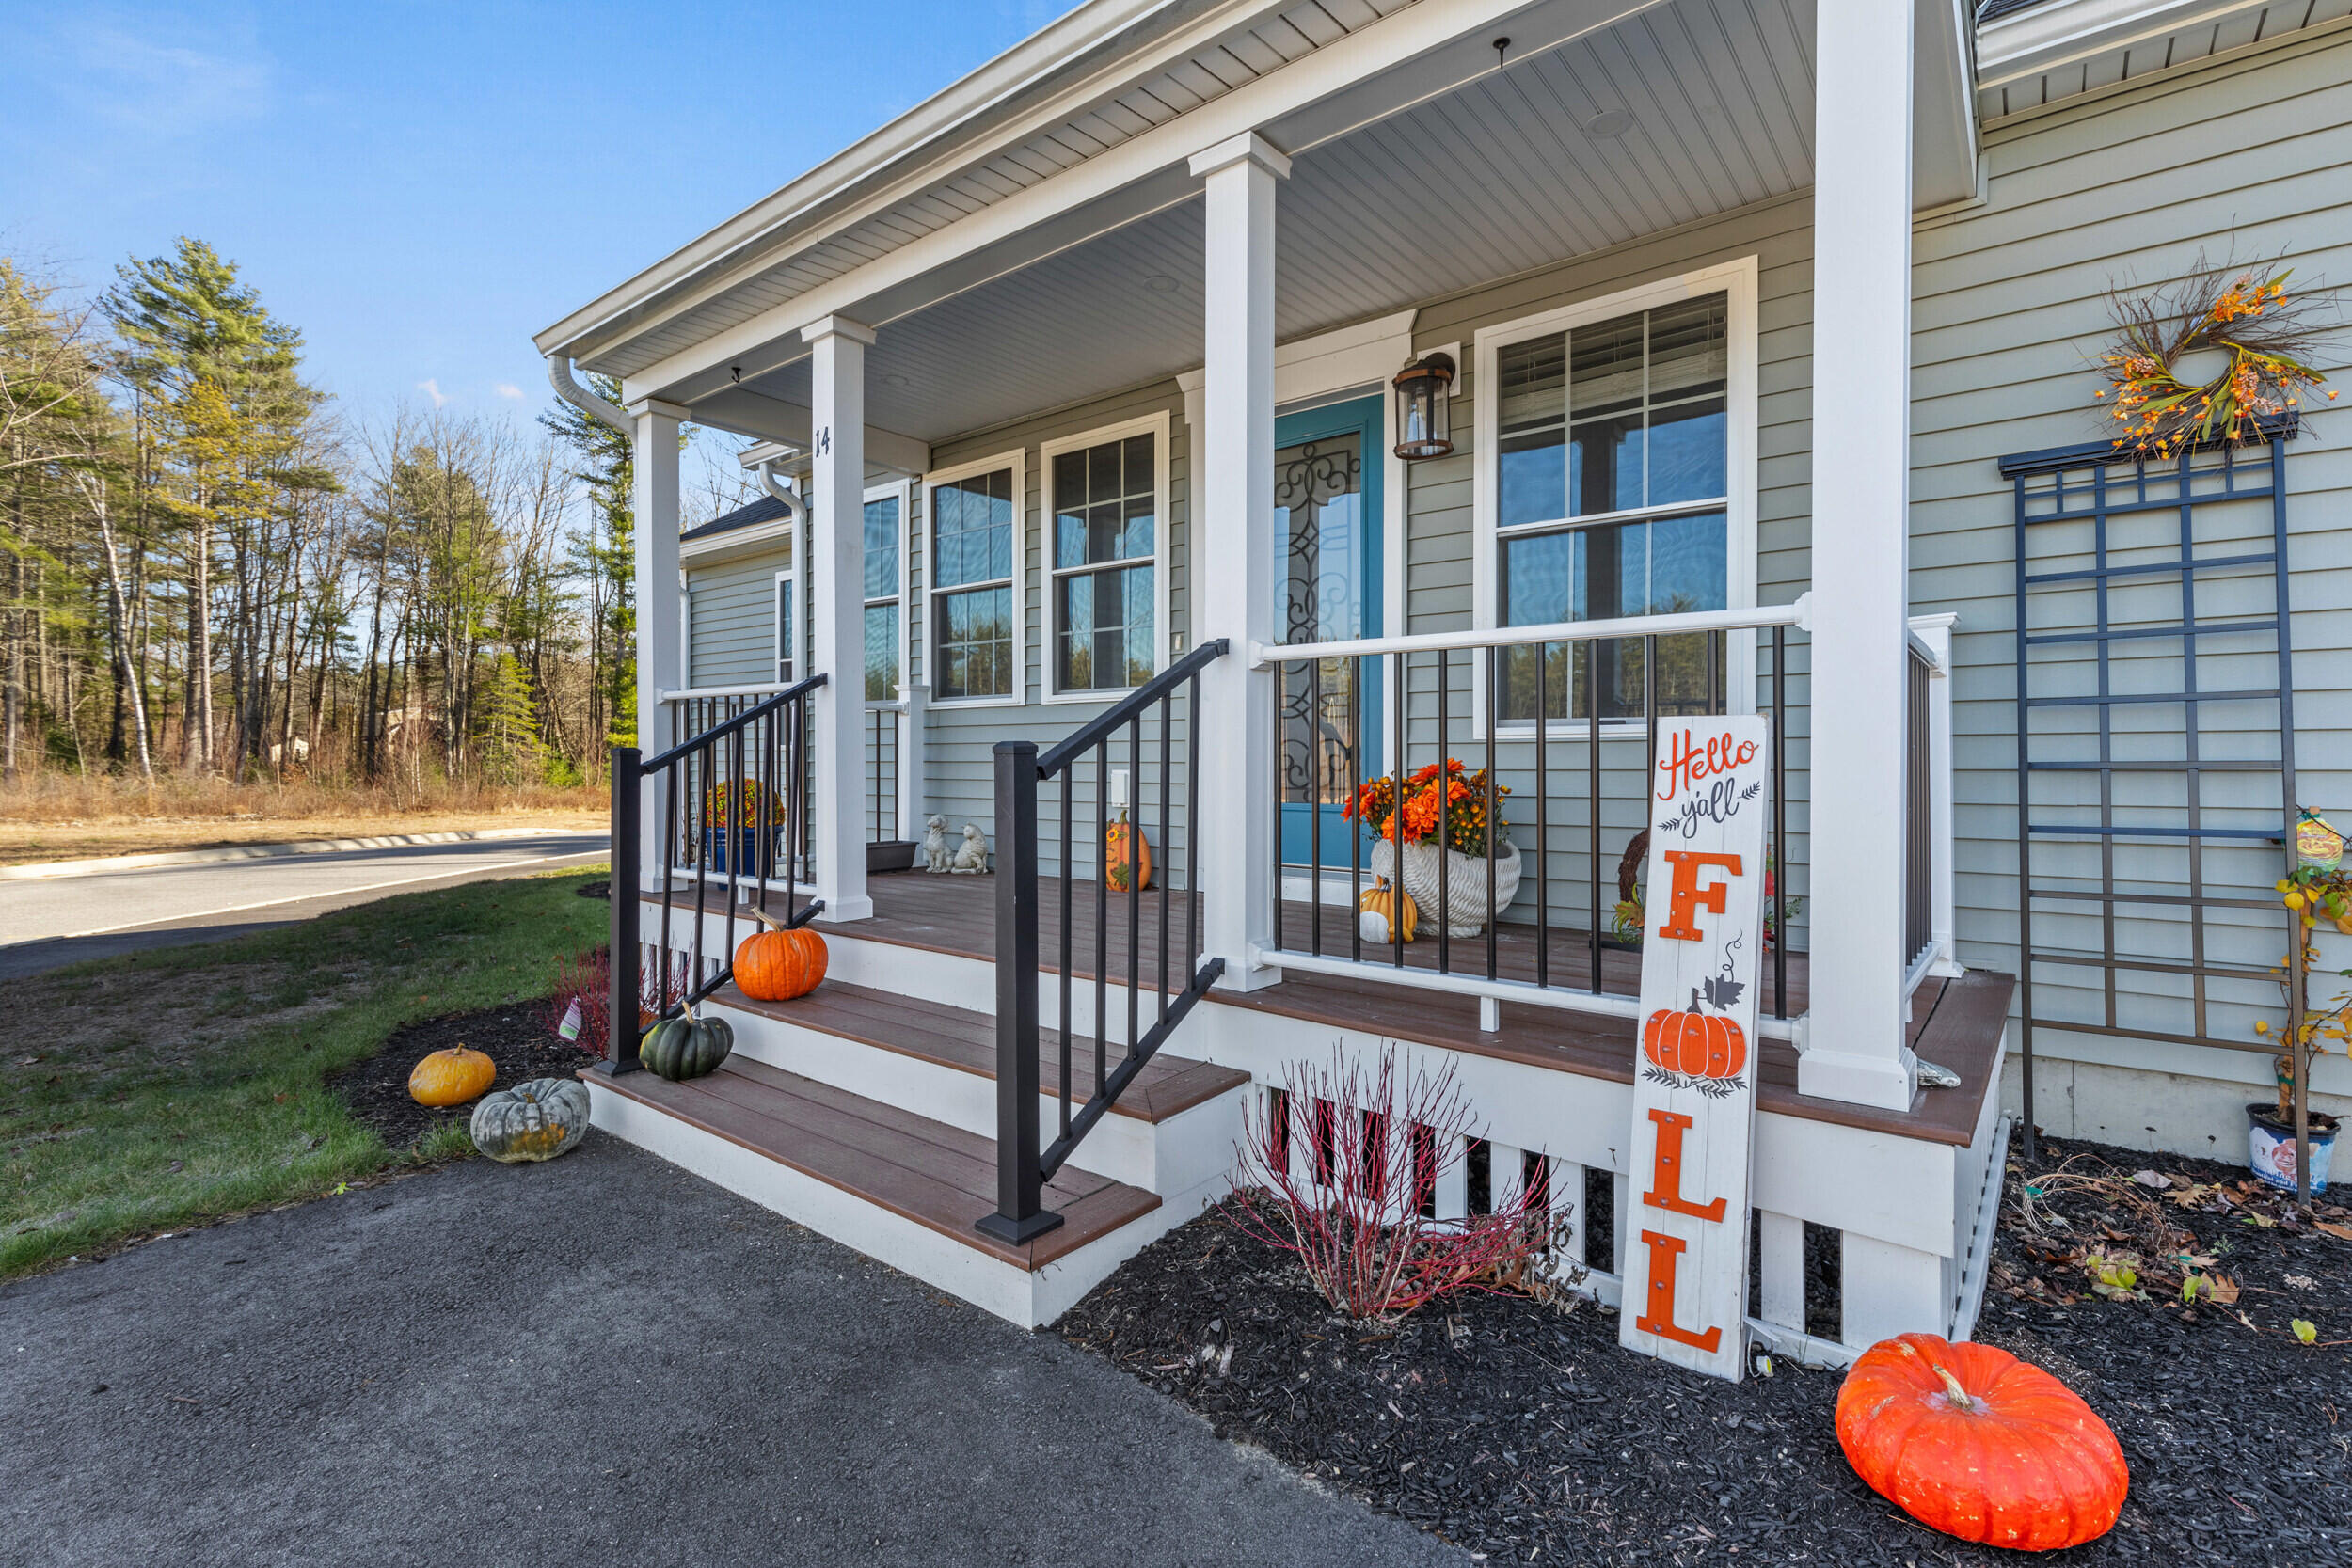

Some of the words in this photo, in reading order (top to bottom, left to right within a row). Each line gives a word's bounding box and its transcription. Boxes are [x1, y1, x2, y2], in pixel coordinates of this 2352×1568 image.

[816, 426, 830, 458] 14
[1657, 729, 1759, 800] Hello
[1681, 777, 1740, 839] y'all
